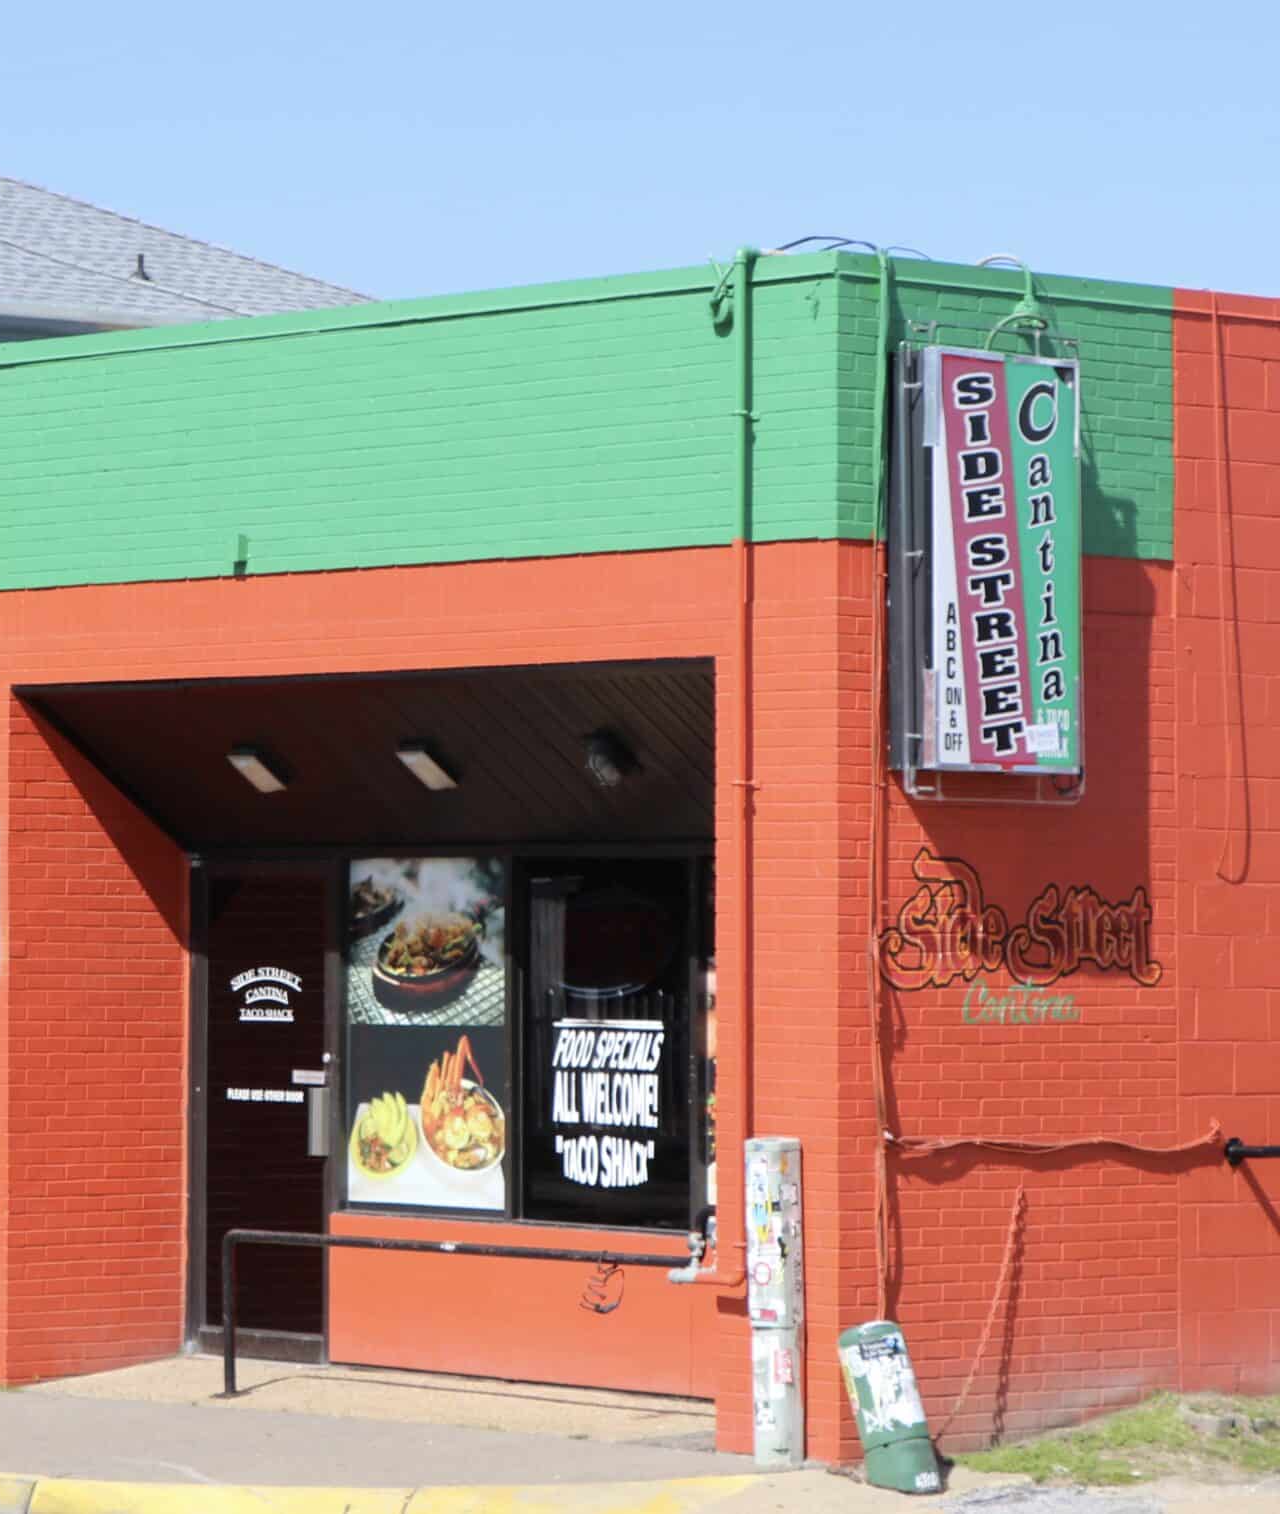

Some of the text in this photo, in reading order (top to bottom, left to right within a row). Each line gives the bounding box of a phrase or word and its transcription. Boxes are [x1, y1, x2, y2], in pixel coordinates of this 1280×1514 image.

[954, 374, 1022, 754] SIDE STREET
[1018, 381, 1066, 702] Cantina
[944, 733, 963, 751] OFF
[879, 847, 1162, 991] Side Street
[230, 967, 302, 988] SIDE STREET
[245, 986, 288, 1003] CANTINA
[962, 976, 1081, 1024] Cantina
[553, 1030, 664, 1071] FOOD SPECIALS
[553, 1071, 658, 1128] ALL WELCOME!
